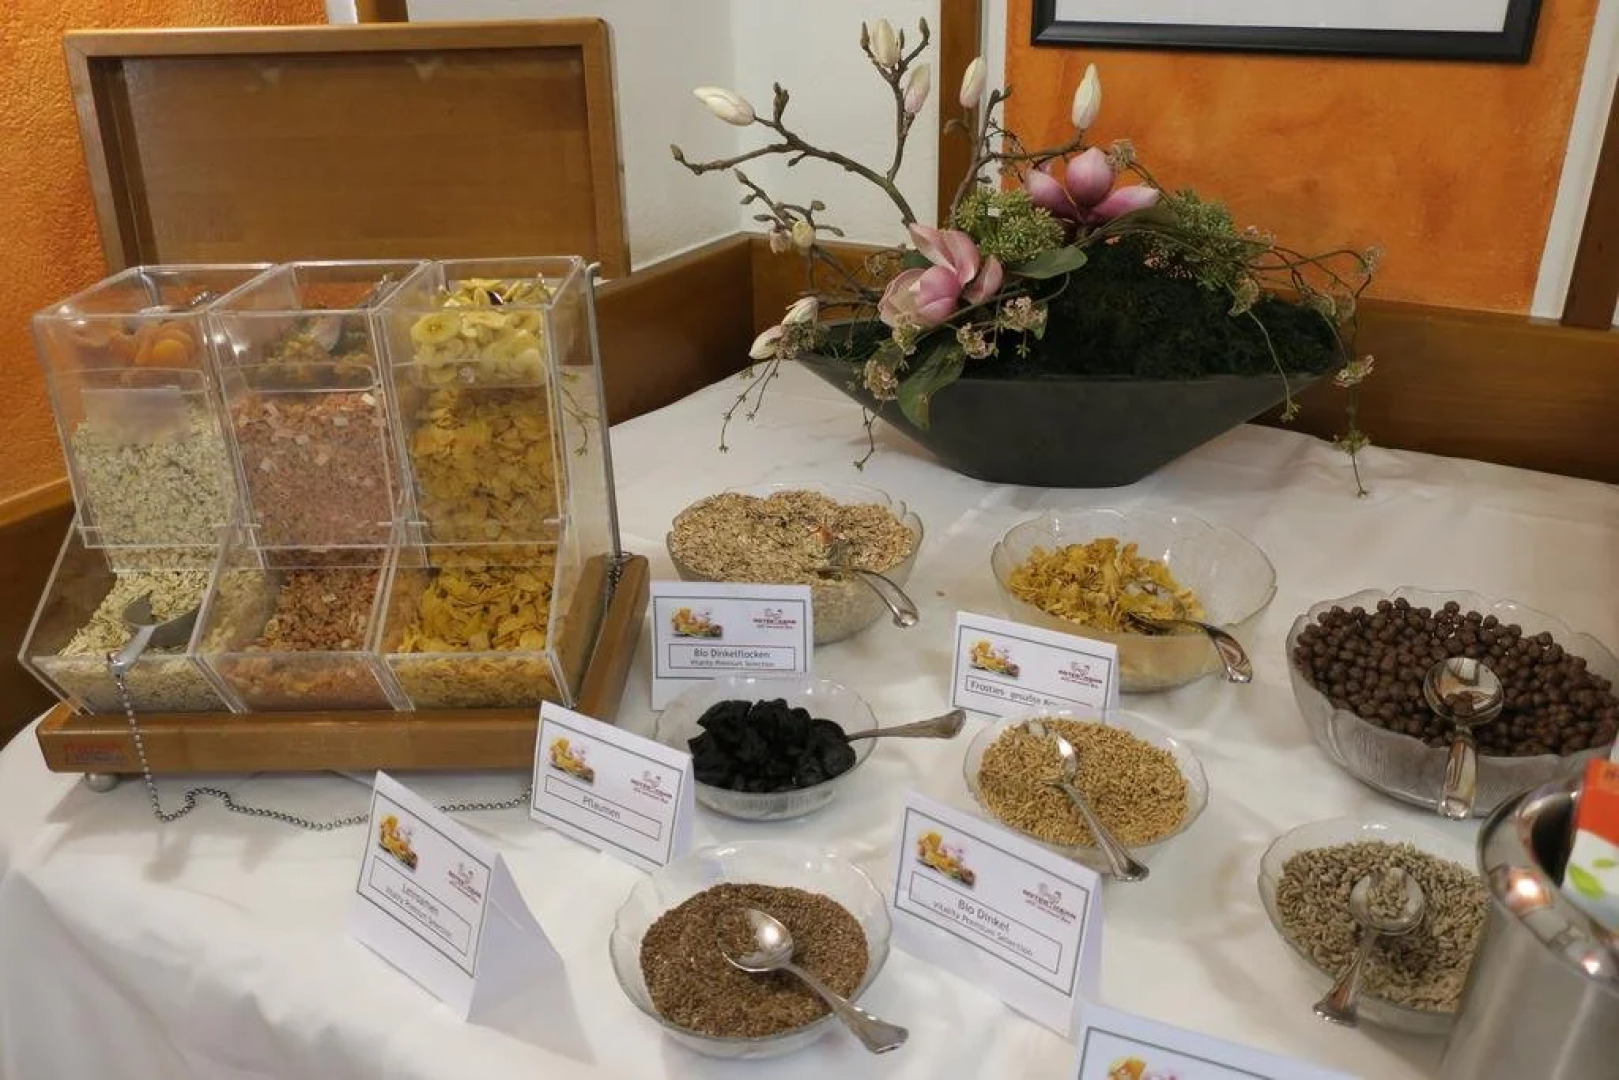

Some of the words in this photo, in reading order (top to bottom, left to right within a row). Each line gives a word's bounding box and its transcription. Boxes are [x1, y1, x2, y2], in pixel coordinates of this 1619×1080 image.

[693, 648, 708, 657] Bio
[711, 648, 771, 659] Dinkelflocken
[957, 898, 975, 915] Bio
[976, 906, 1010, 933] Dinkel
